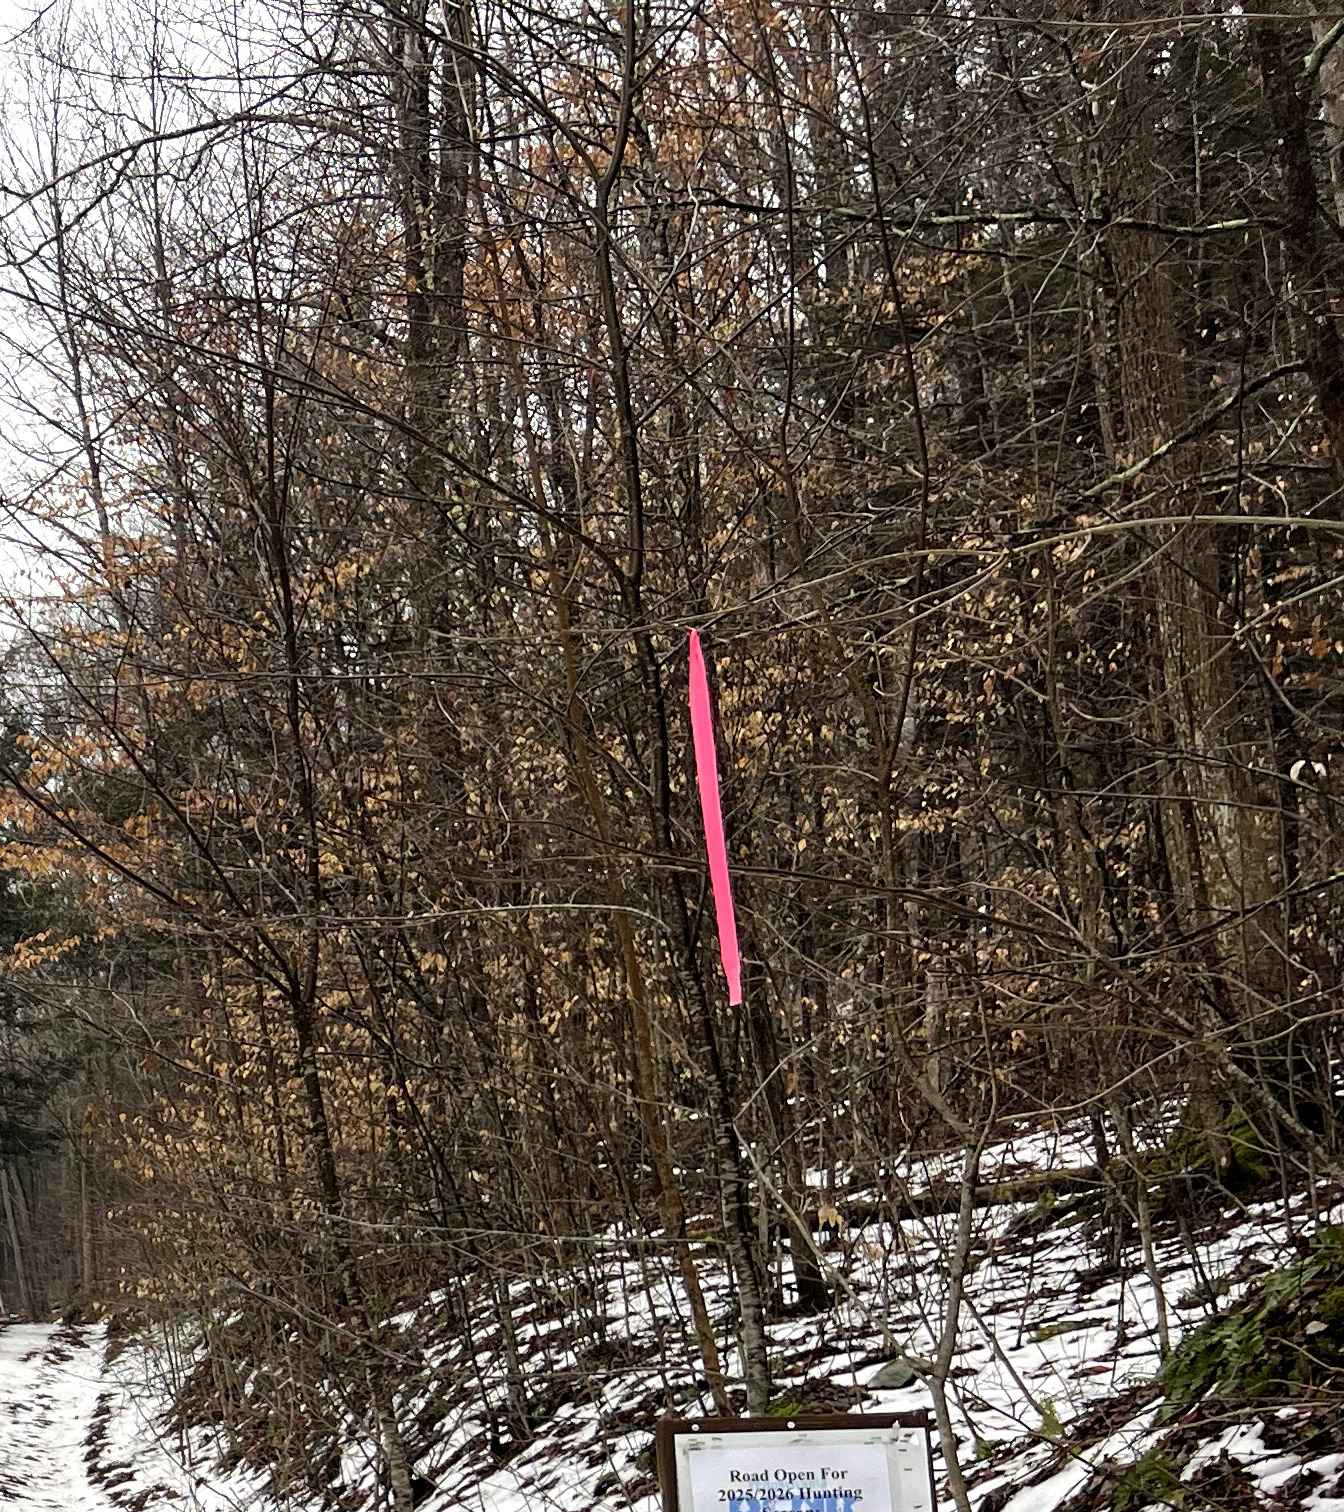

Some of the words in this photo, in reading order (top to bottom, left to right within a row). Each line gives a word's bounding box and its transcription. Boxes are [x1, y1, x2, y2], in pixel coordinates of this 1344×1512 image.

[730, 1469, 769, 1482] Road
[774, 1468, 815, 1484] Open
[820, 1467, 848, 1480] For
[718, 1487, 794, 1501] 2025/2026
[799, 1485, 864, 1502] Hunting
